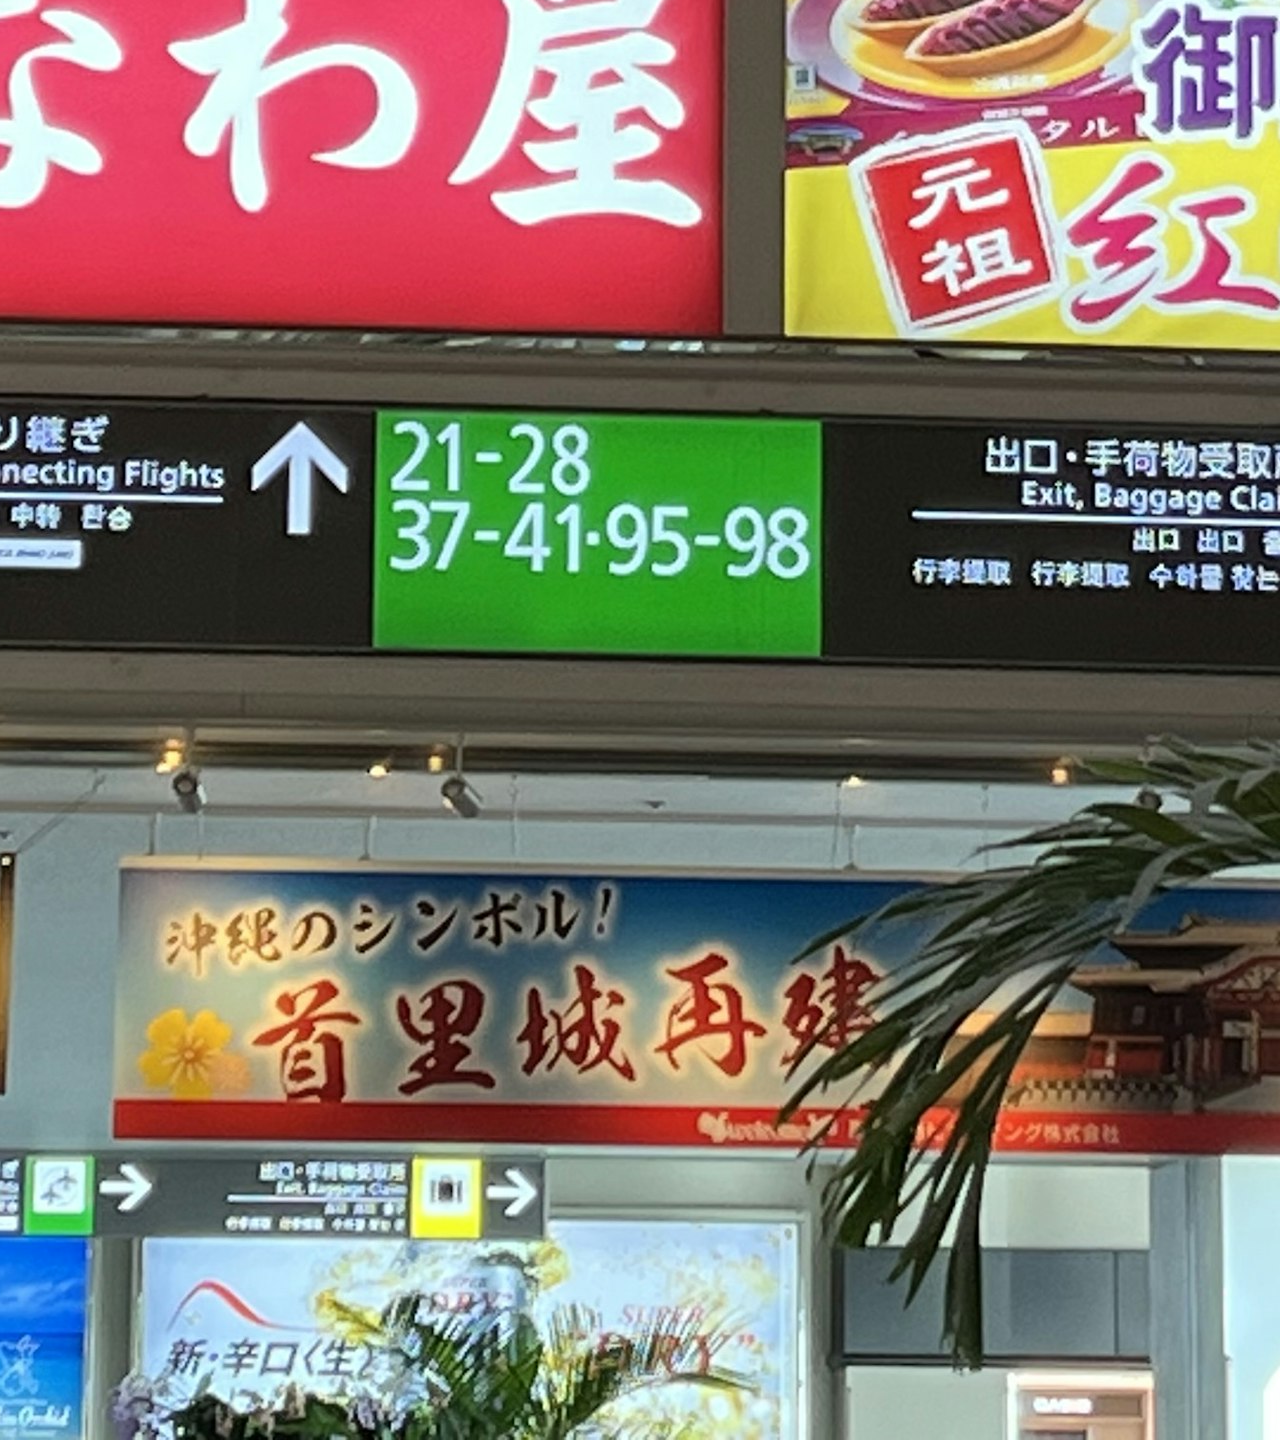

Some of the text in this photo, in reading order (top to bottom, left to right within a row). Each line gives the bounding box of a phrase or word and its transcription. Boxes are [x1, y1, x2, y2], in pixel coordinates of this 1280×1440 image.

[911, 158, 1033, 297] 元祖
[124, 460, 225, 493] Flights
[390, 421, 592, 496] 21-28
[1021, 480, 1084, 511] Exit,
[1093, 483, 1221, 515] Baggage
[1132, 528, 1181, 552] 出口
[1197, 529, 1245, 553] 出口
[164, 887, 616, 974] 沖縄のシンボル!
[252, 946, 896, 1105] 首里城再建
